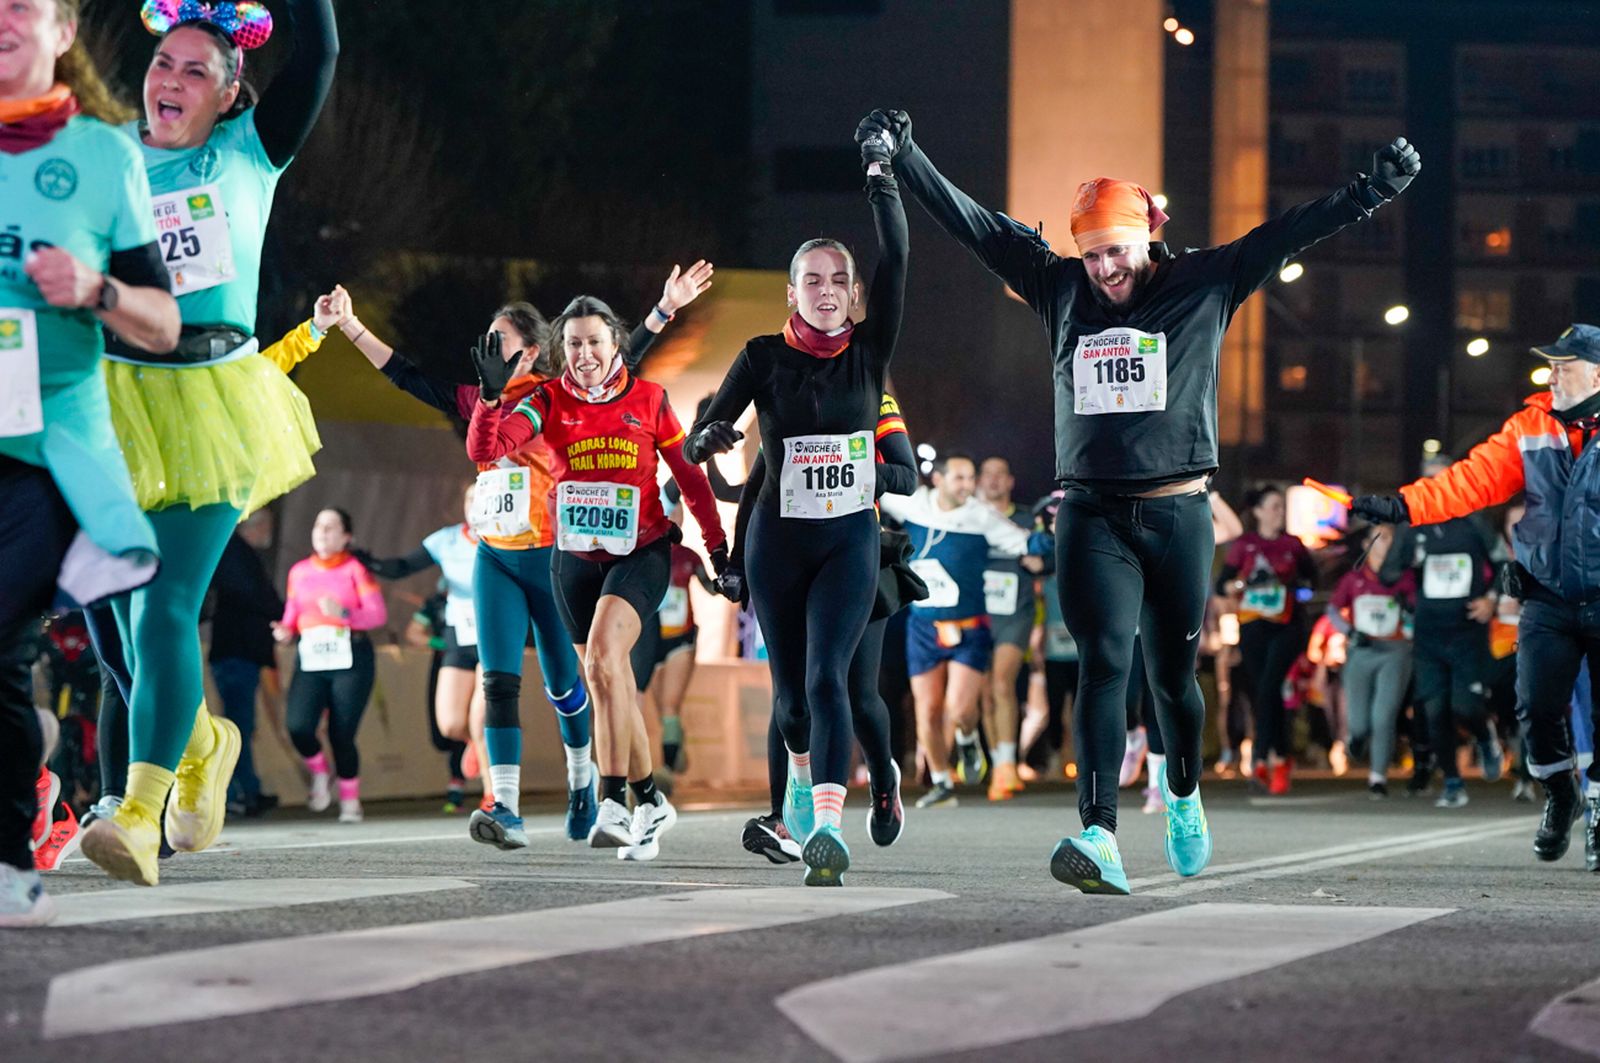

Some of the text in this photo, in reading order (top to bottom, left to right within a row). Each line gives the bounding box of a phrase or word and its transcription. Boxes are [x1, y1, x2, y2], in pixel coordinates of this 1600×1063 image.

[164, 204, 177, 215] DE
[1093, 336, 1131, 347] NOCHE DE
[1083, 349, 1100, 359] SAN
[1101, 345, 1131, 357] ANTÓN
[1094, 357, 1145, 384] 1185
[567, 436, 639, 458] KABRAS LOKAS
[803, 444, 830, 453] NOCHE
[831, 443, 841, 453] DE
[569, 454, 595, 471] TRAIL
[792, 455, 811, 465] SAN
[811, 452, 842, 464] ANTÓN
[802, 463, 855, 490] 1186
[575, 488, 600, 497] NOCHE
[600, 489, 609, 497] DE
[566, 496, 582, 505] SAN
[566, 505, 629, 531] 12096
